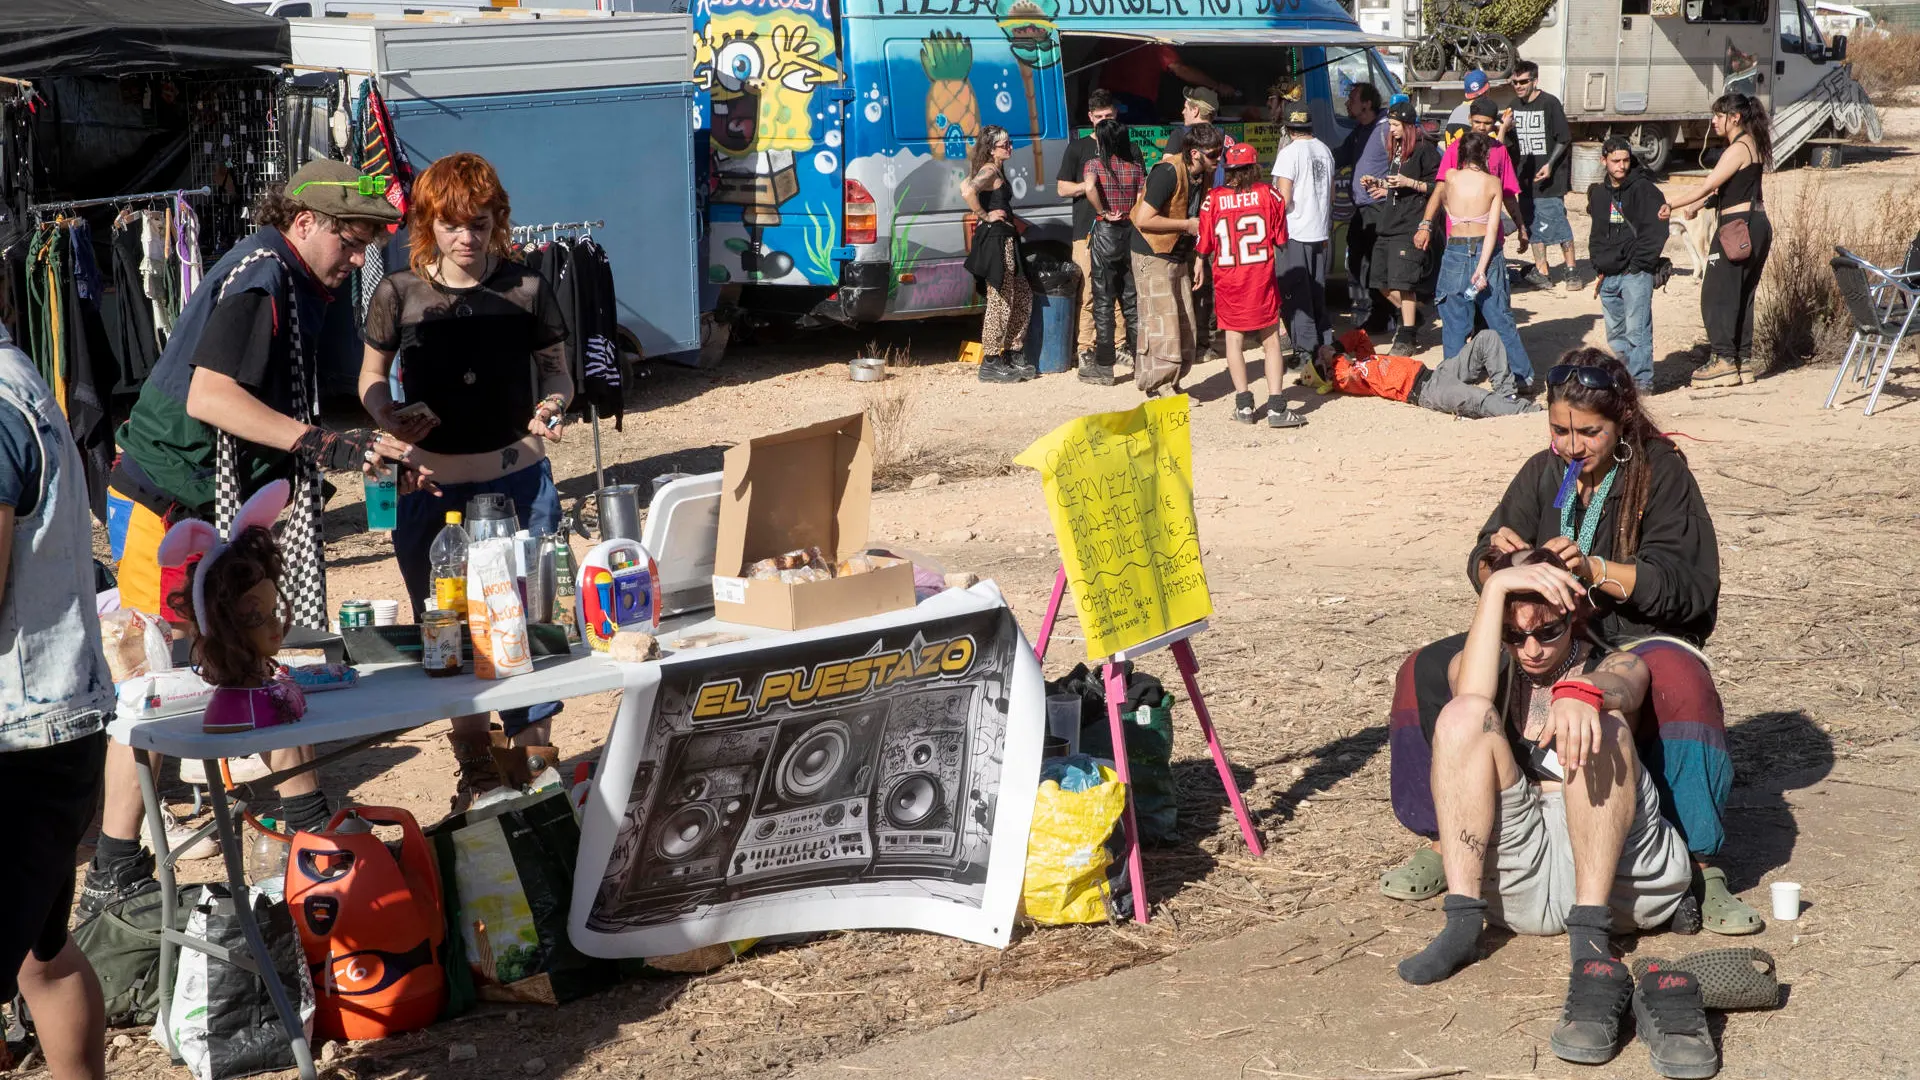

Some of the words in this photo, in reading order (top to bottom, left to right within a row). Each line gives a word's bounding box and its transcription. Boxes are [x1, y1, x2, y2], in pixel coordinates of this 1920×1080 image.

[1219, 190, 1259, 211] DILFER
[1214, 212, 1269, 267] 12
[1057, 462, 1143, 508] CERVEZA
[1077, 529, 1150, 571] SANDWICH
[1156, 553, 1192, 578] TABACO
[1081, 579, 1134, 613] OFERTAS
[692, 681, 751, 719] EL
[756, 638, 974, 709] PUESTAZO
